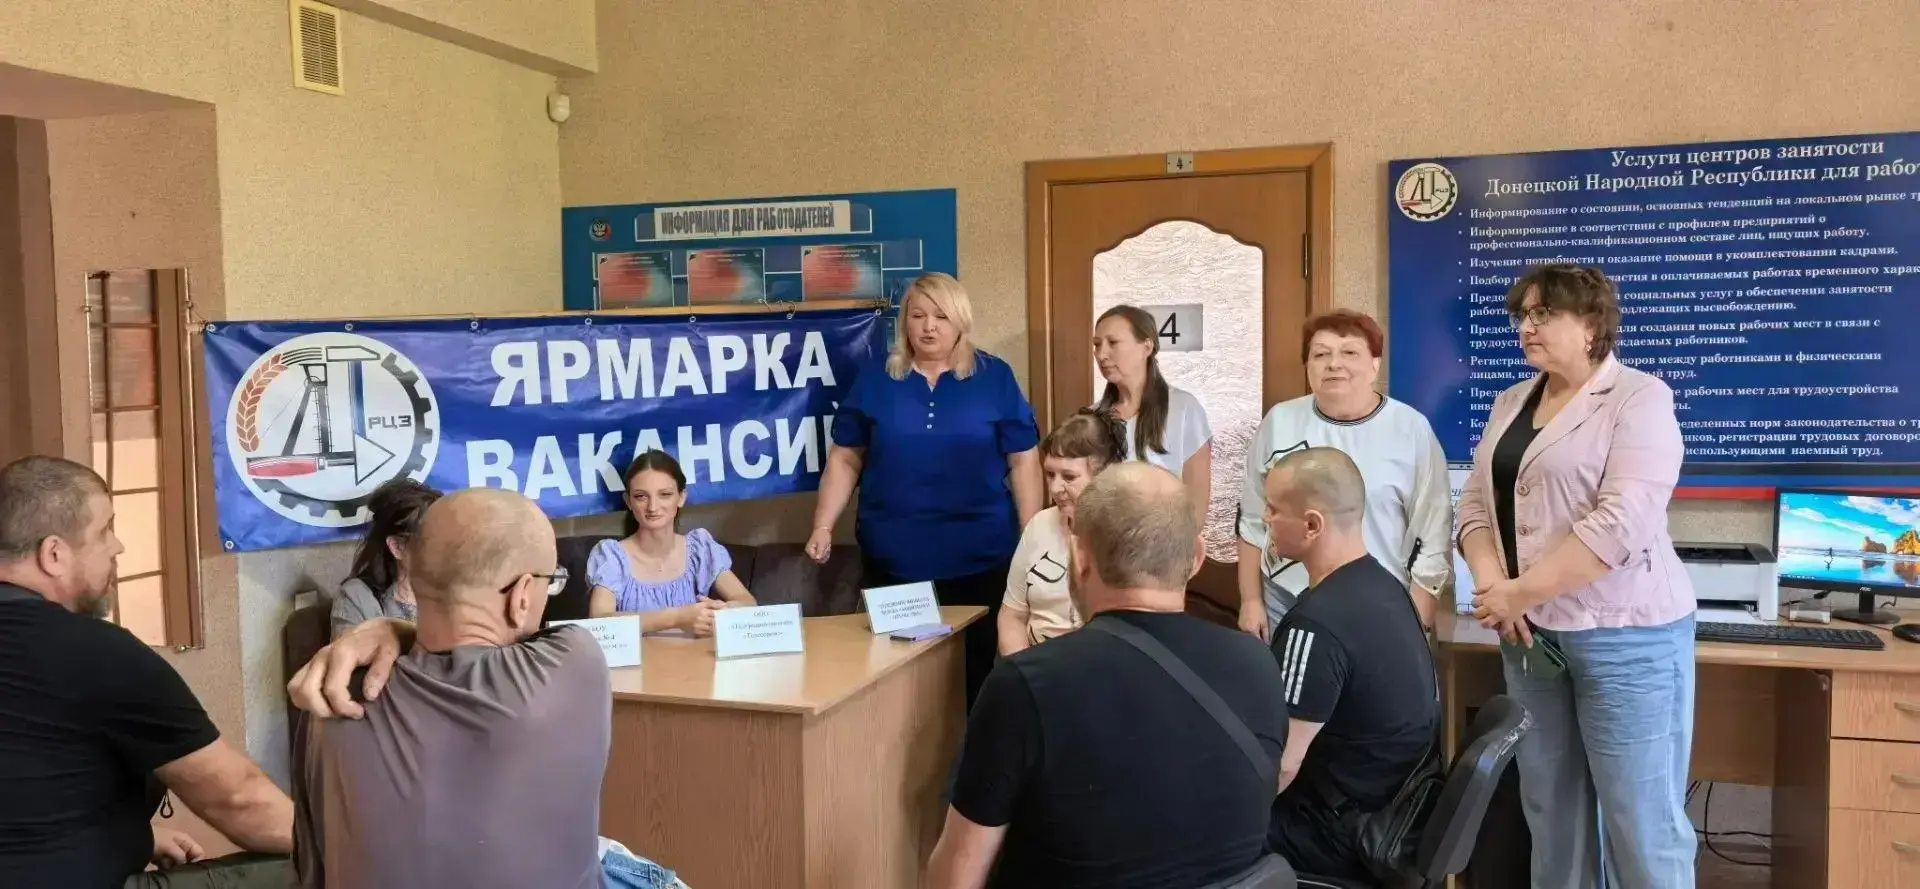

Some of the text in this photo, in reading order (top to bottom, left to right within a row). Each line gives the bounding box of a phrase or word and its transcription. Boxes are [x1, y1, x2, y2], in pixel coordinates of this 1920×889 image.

[1611, 141, 1884, 169] Услуги центров занятости
[1176, 157, 1184, 170] 4
[1485, 159, 1920, 198] Донецкой Народной Республики для рабо
[1470, 208, 1568, 219] Информирование
[1580, 205, 1644, 213] состоянии,
[1646, 202, 1704, 210] основных
[1707, 197, 1773, 208] тенденций
[1794, 195, 1862, 204] локальном
[1866, 193, 1907, 203] рынке
[661, 202, 835, 236] ИНФОРМАЦИЯ ДЛЯ РАБОТОДАТЕЛЕЙ
[1470, 227, 1568, 237] Информирование
[1580, 223, 1656, 232] соответствии
[1668, 219, 1730, 230] профилем
[1733, 215, 1815, 227] предприятий
[1470, 234, 1687, 250] профессионально-квалификационном
[1690, 233, 1735, 241] составе
[1768, 231, 1820, 240] ищущих
[1823, 227, 1870, 239] работу.
[1470, 258, 1523, 268] Изучение
[1525, 255, 1595, 265] потребности
[1607, 255, 1662, 263] оказание
[1725, 250, 1837, 259] укомплектовании
[1470, 276, 1511, 285] Подбор
[1660, 272, 1749, 280] оплачиваемых
[1752, 268, 1802, 279] работах
[1805, 267, 1879, 278] временного
[1624, 292, 1697, 300] социальных
[1700, 291, 1734, 300] услуг
[1746, 287, 1826, 296] обеспечении
[1828, 286, 1893, 294] занятости
[1620, 306, 1691, 314] одлежащих
[1693, 302, 1797, 311] высвобождению.
[1158, 312, 1181, 345] 4
[1616, 325, 1637, 333] для
[1640, 324, 1695, 332] создания
[1739, 320, 1790, 331] рабочих
[1674, 335, 1748, 346] работников.
[1658, 357, 1697, 365] между
[1700, 354, 1781, 365] работниками
[1795, 352, 1882, 363] физическими
[489, 331, 837, 407] ЯРМАРКА
[1666, 371, 1697, 379] труд.
[1684, 387, 1734, 398] рабочих
[1792, 384, 1899, 396] трудоустройства
[367, 414, 413, 430] РЦЗ
[1749, 421, 1781, 429] норм
[1719, 434, 1797, 443] регистрации
[1800, 434, 1860, 442] трудовых
[465, 401, 839, 500] ВАКАНСИ
[1684, 445, 1884, 456] использующими наемный труд.
